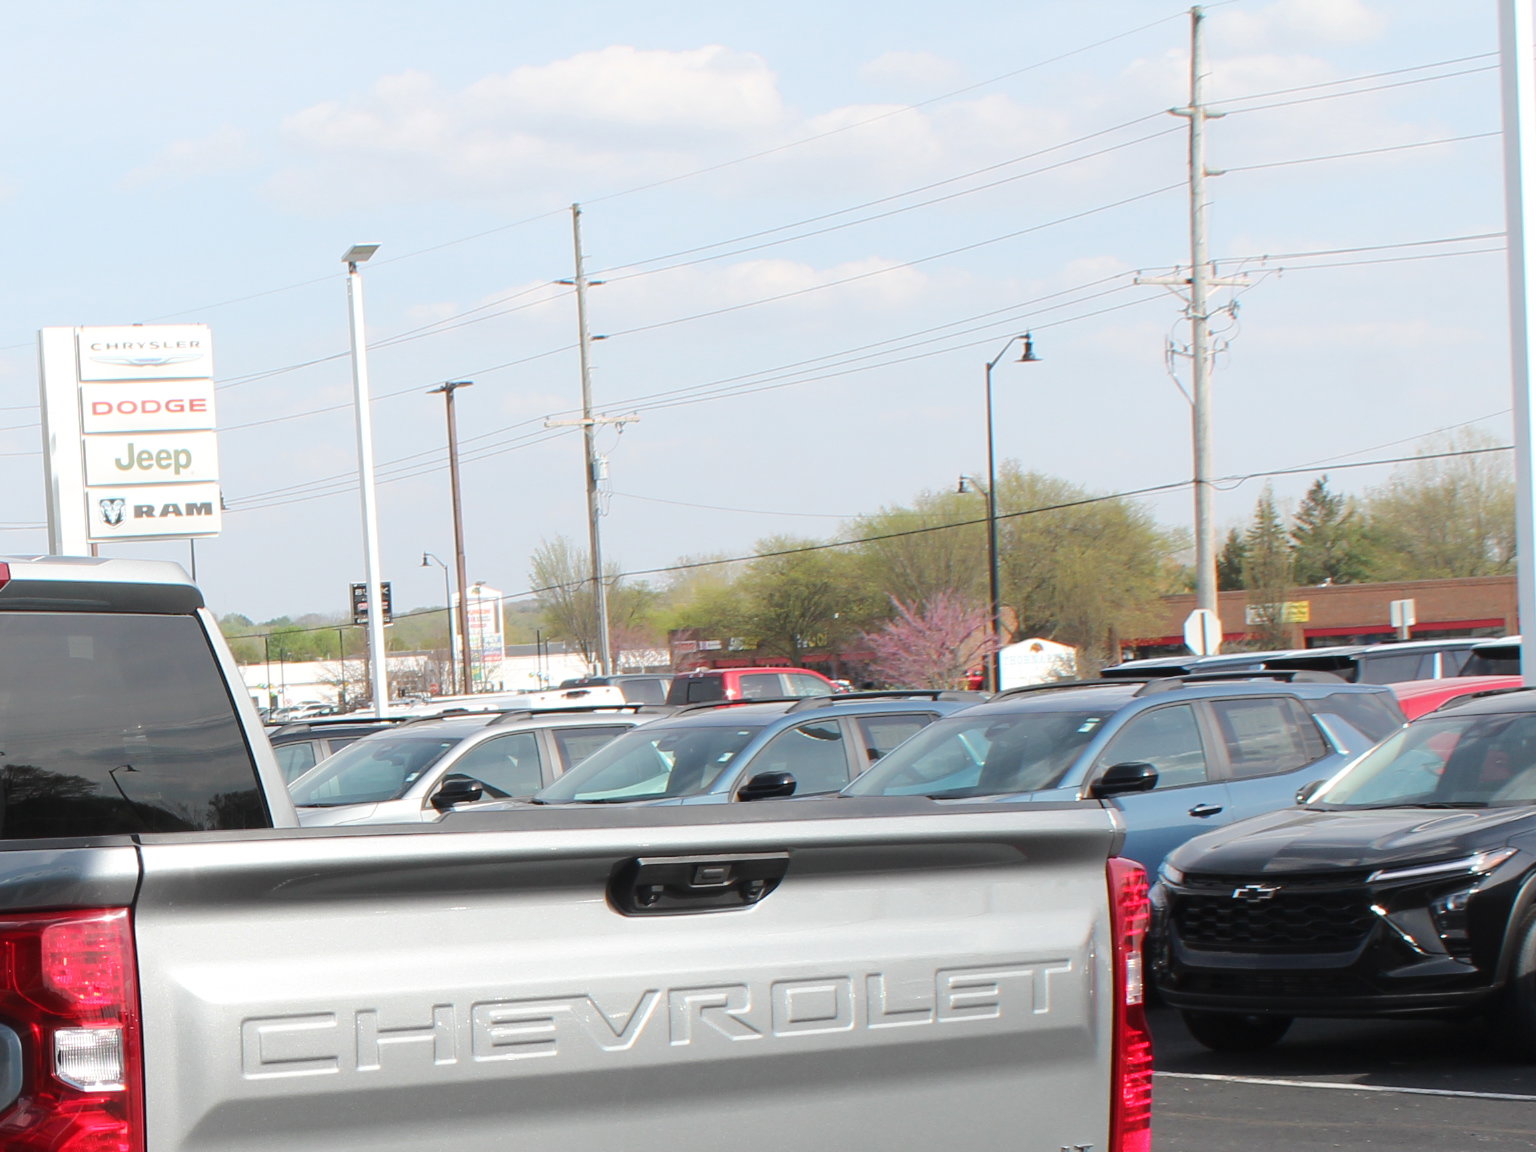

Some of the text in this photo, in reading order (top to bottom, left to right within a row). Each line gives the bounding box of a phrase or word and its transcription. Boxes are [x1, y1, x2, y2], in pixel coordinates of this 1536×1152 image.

[90, 340, 201, 351] CHRYSLER
[91, 398, 208, 416] DODGE
[114, 442, 193, 476] Jeep
[133, 501, 213, 519] RAM
[239, 957, 1073, 1080] CHEVROLET
